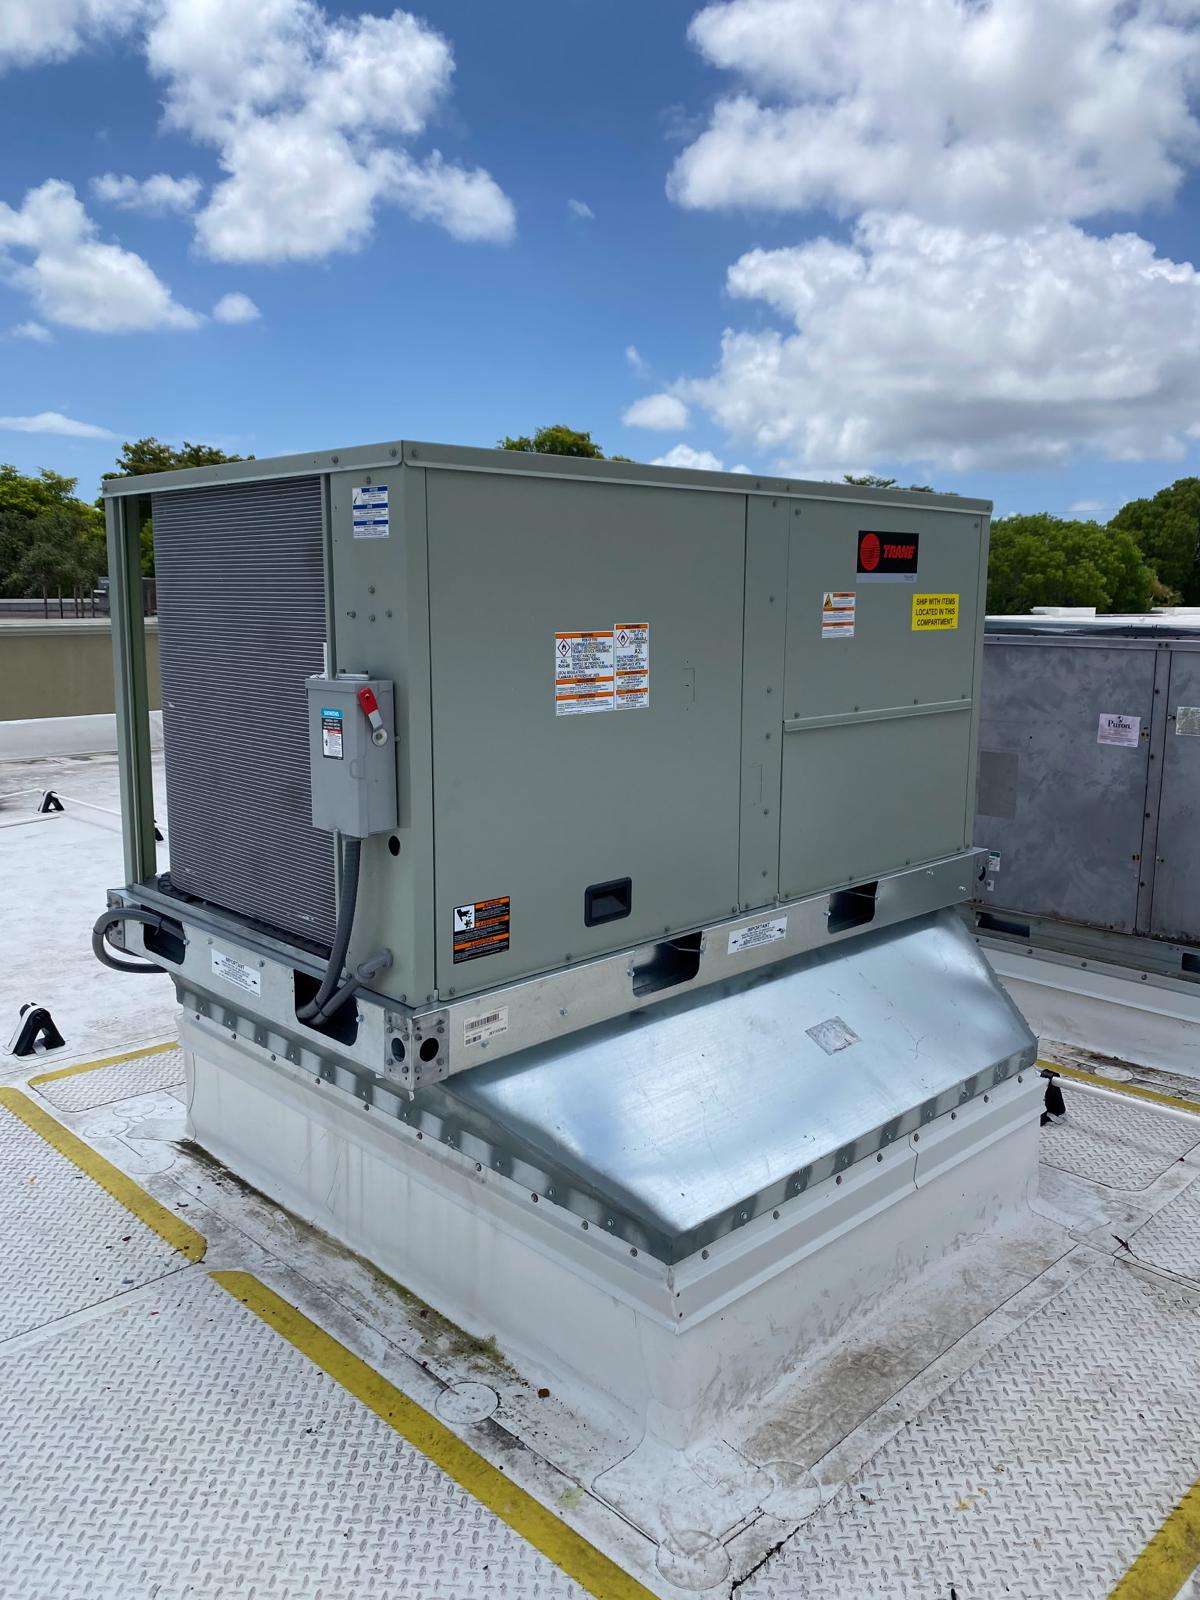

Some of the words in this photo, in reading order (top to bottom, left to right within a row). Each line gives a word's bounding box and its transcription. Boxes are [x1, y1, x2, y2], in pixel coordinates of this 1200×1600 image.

[883, 544, 915, 559] TRANE
[916, 598, 928, 606] SHIP
[941, 597, 955, 605] ITEMS
[915, 608, 938, 616] LOCATED
[945, 607, 955, 615] THIS
[917, 618, 953, 626] COMPARTMENT
